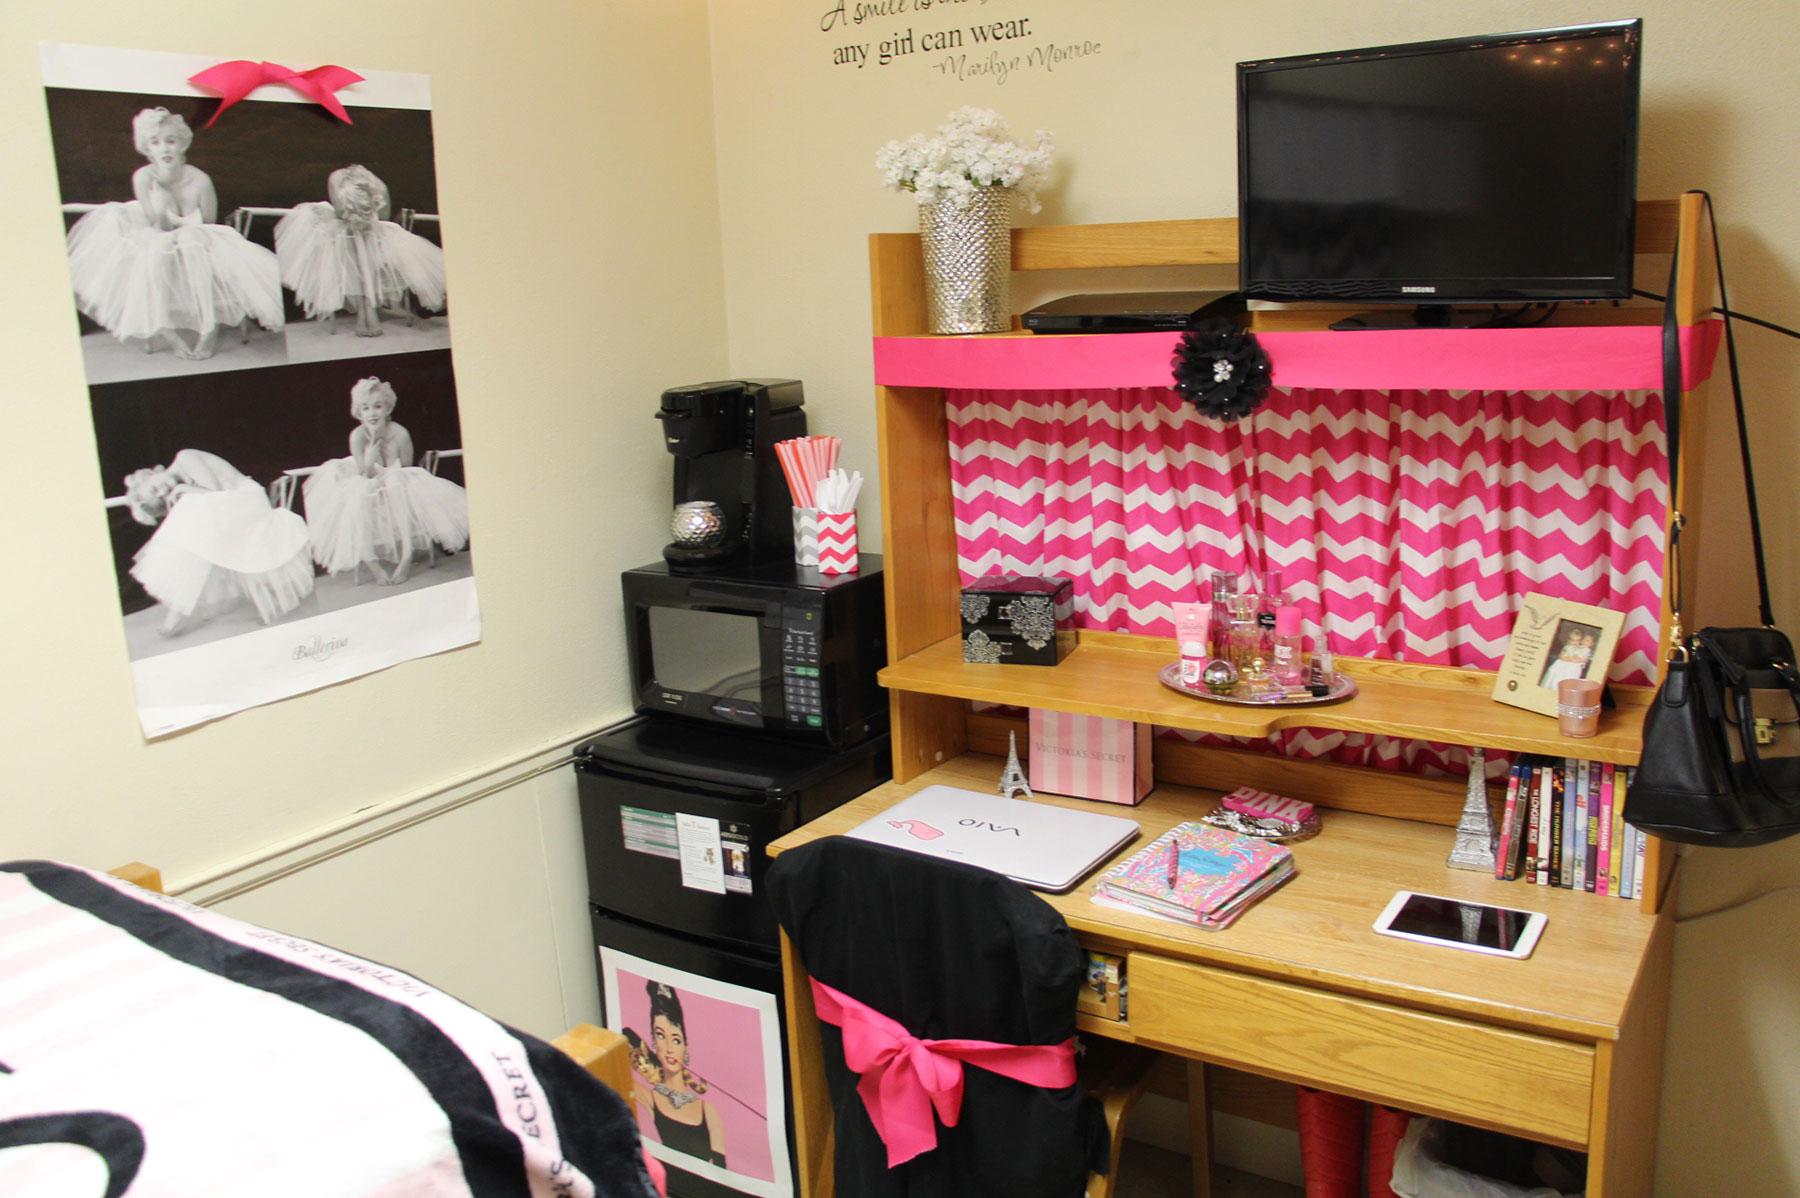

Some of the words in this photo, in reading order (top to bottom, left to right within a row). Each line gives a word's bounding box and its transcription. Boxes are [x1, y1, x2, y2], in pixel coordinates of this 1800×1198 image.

[833, 43, 869, 69] any
[879, 28, 914, 65] girl
[921, 28, 963, 52] can
[970, 17, 1032, 41] wear.
[1027, 40, 1102, 72] Monroe
[1036, 741, 1089, 759] VICTORIA'S
[1091, 751, 1128, 763] SECRET
[1222, 786, 1315, 821] PINK
[1530, 796, 1541, 829] LONGEST
[958, 818, 1021, 837] VAIO
[1529, 829, 1539, 845] RIDE
[1553, 815, 1561, 844] HUNGER
[1601, 805, 1611, 851] BRIDESMAIDS
[490, 1051, 541, 1141] ECRET
